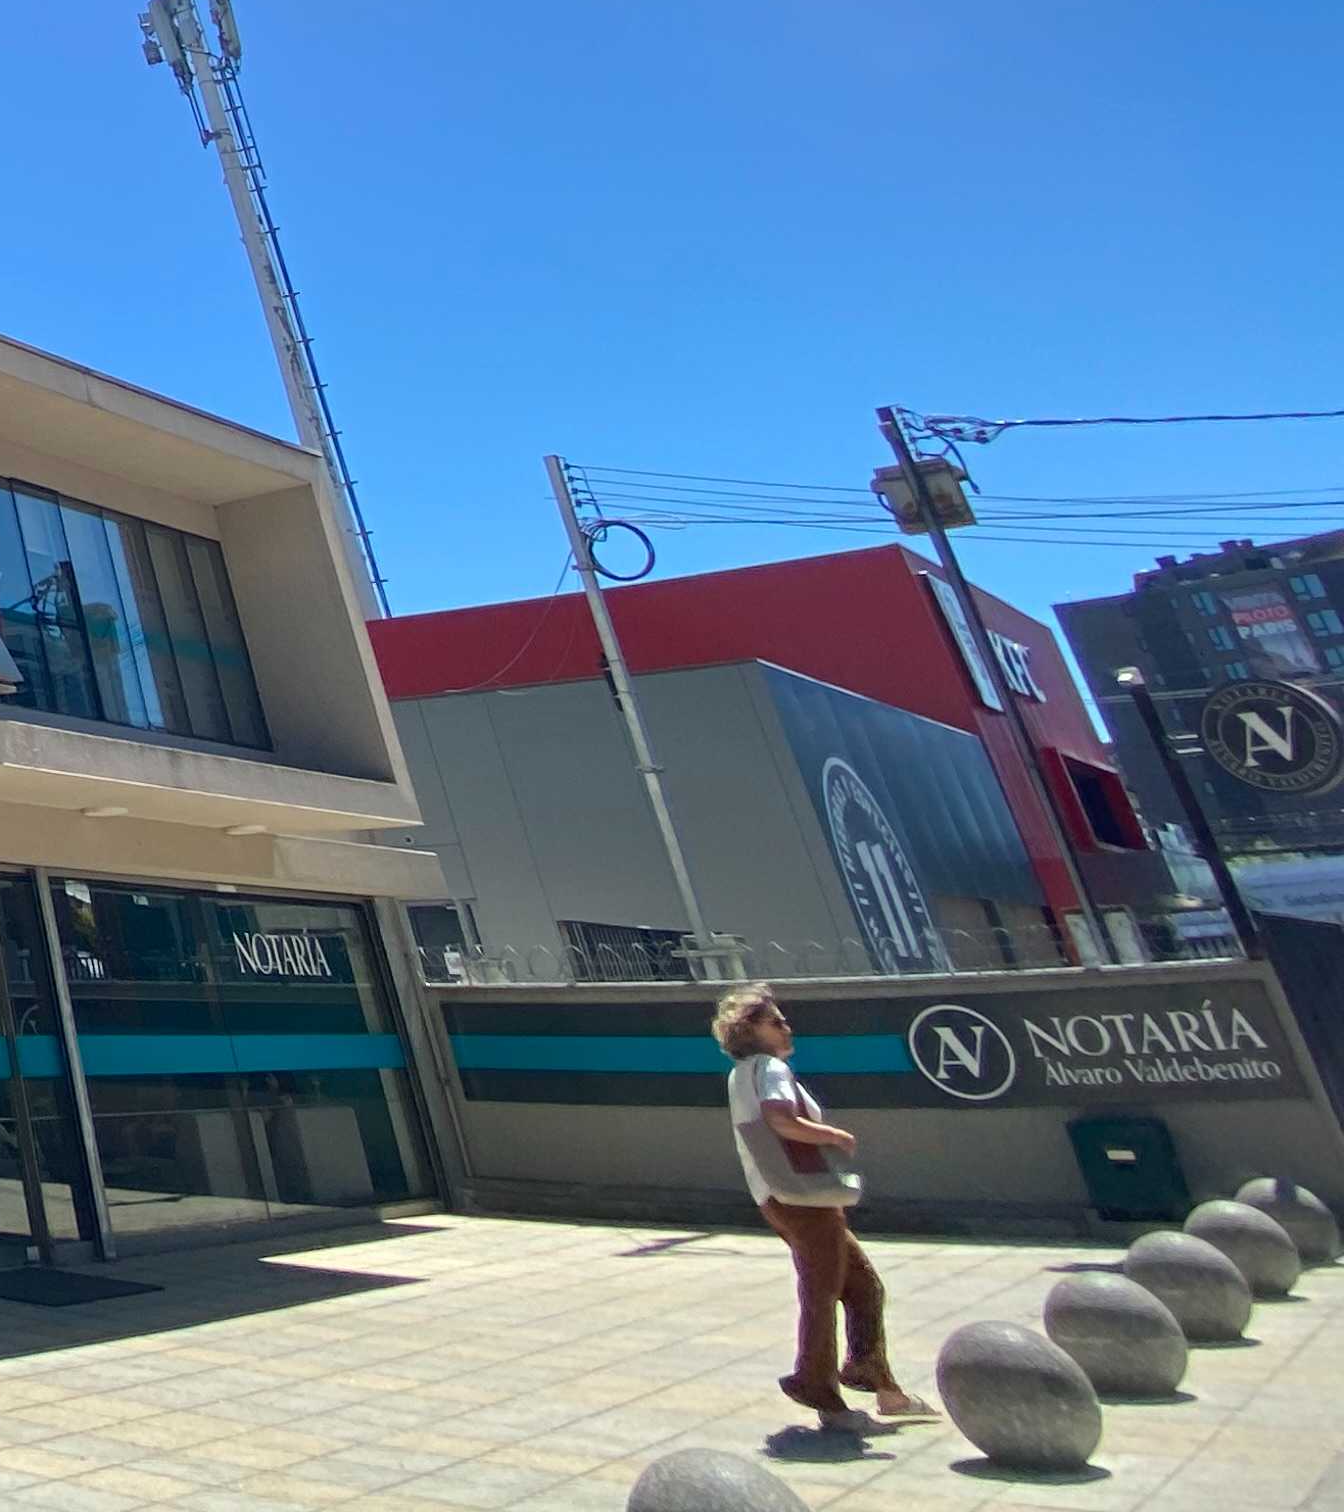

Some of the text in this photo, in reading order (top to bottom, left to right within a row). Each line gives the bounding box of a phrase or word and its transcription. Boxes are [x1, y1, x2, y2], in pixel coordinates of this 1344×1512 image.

[985, 628, 1048, 704] KFC
[232, 928, 333, 977] NOTARÍA
[1023, 1000, 1269, 1059] NOTARÍA
[1044, 1055, 1282, 1088] Álvaro Valdebenito
